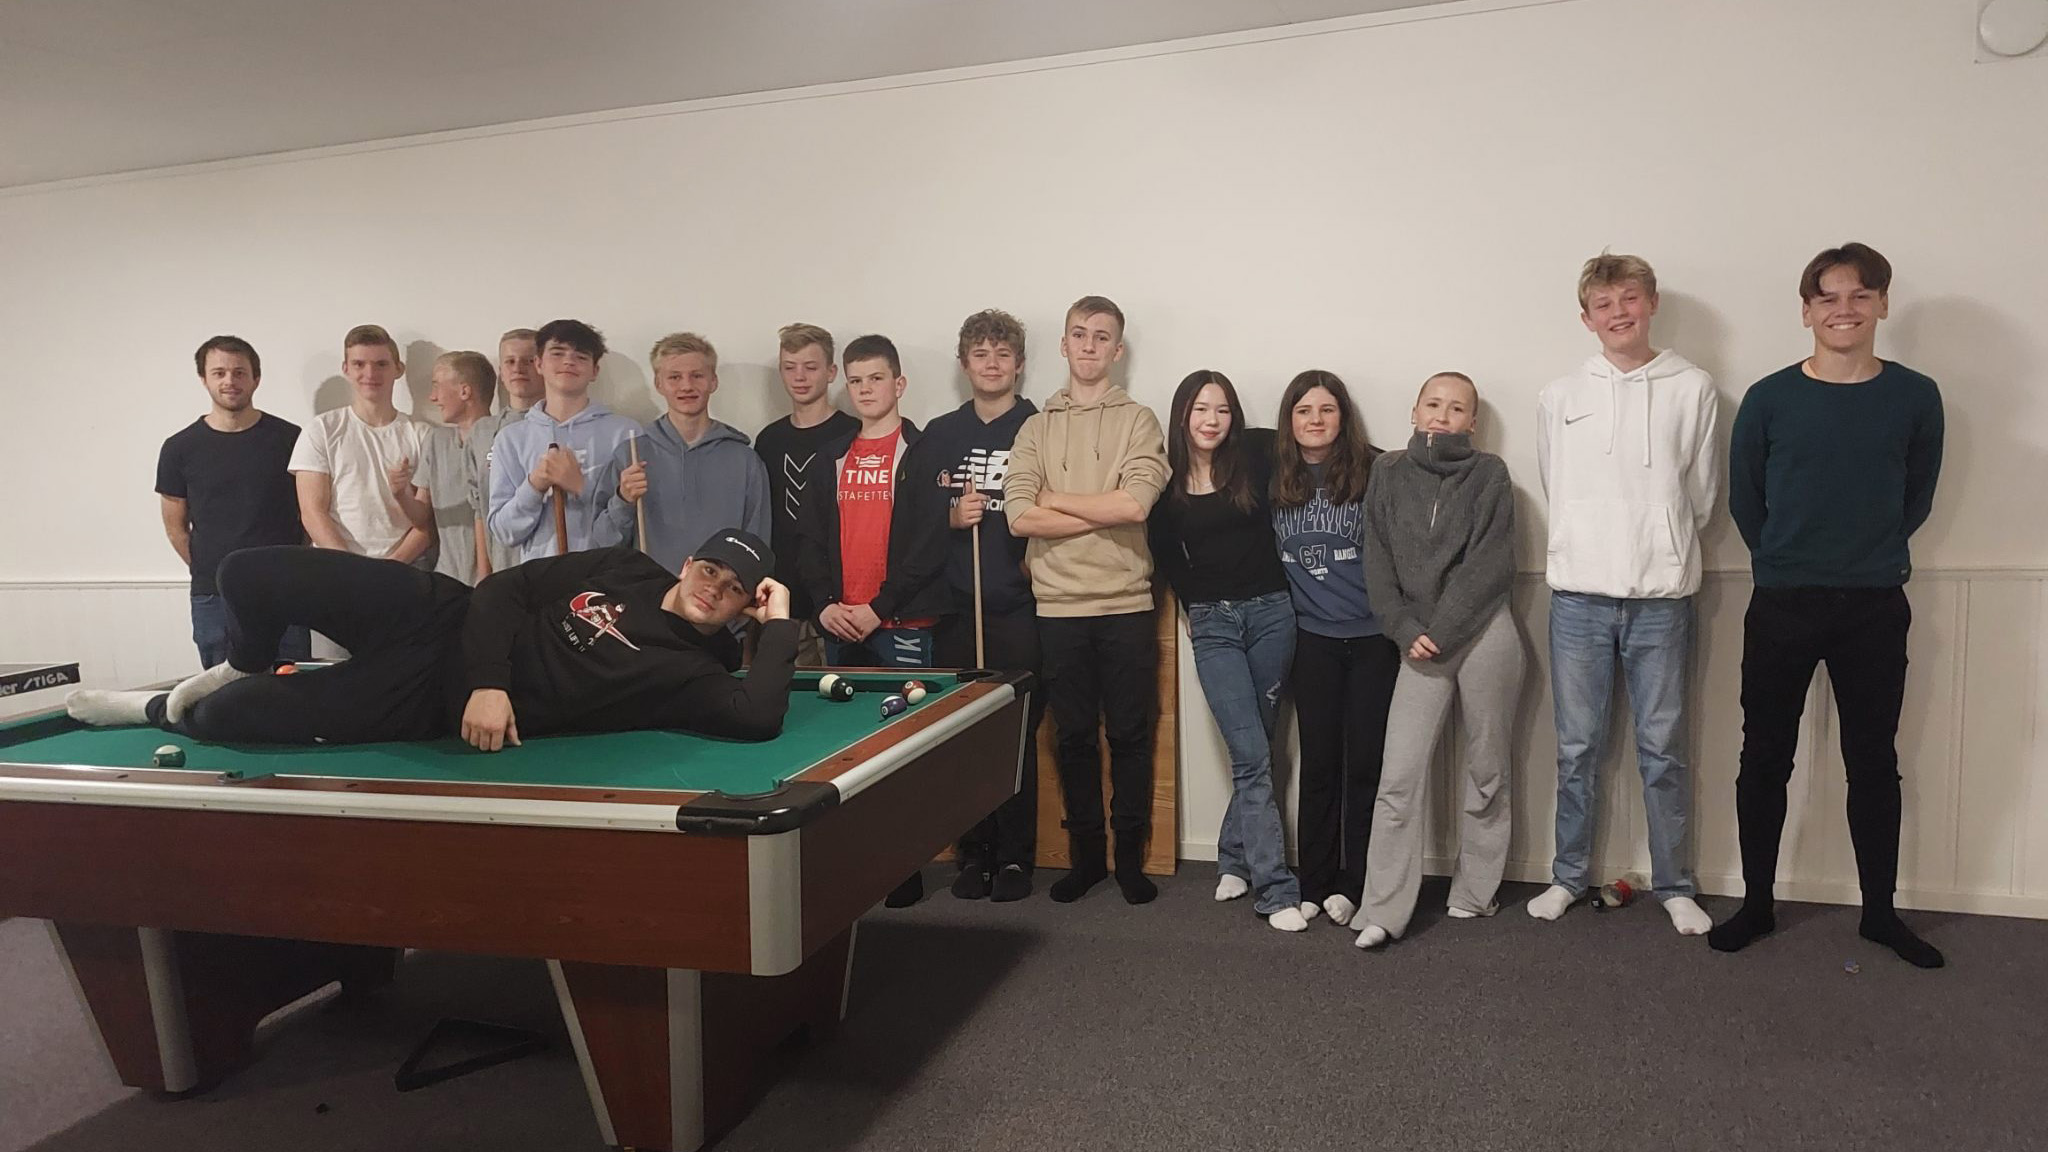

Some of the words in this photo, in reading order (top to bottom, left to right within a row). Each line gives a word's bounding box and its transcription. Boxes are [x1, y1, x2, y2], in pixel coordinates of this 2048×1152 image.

[845, 469, 889, 485] TINE
[839, 490, 892, 501] STAFETTE
[1299, 544, 1327, 569] 67
[23, 672, 69, 690] STIGA
